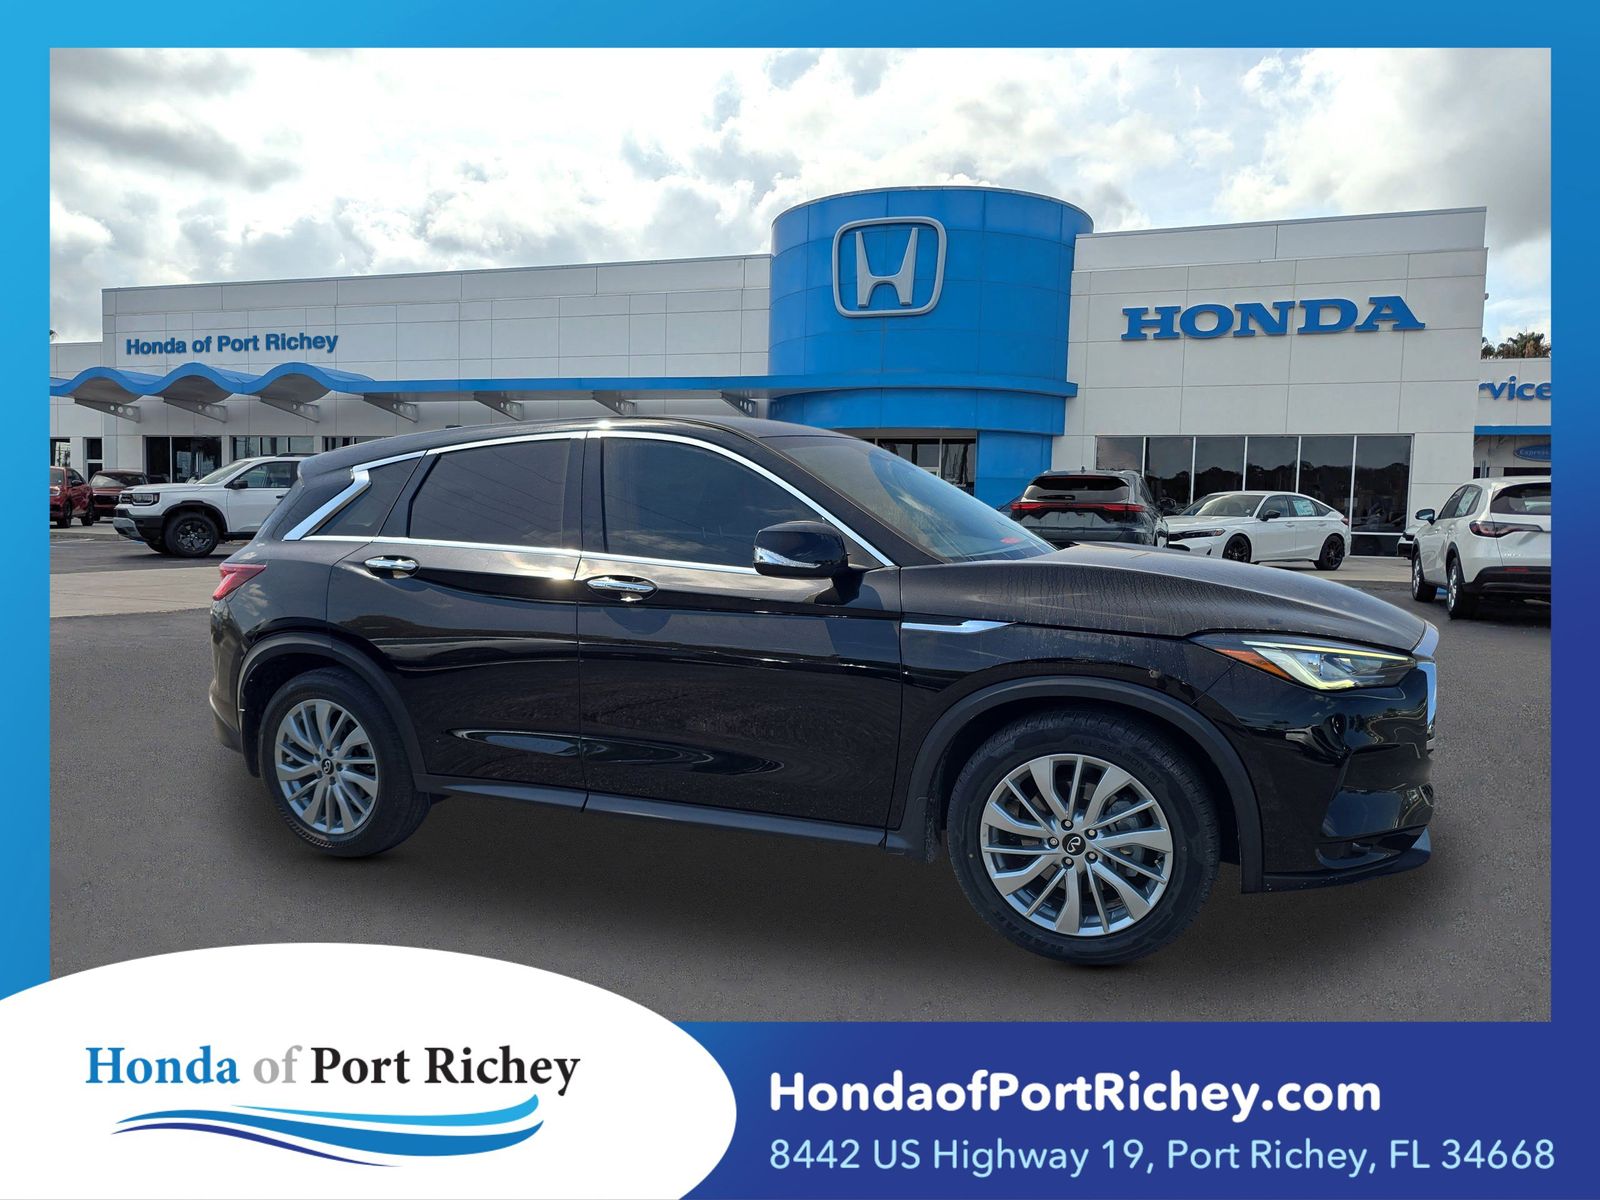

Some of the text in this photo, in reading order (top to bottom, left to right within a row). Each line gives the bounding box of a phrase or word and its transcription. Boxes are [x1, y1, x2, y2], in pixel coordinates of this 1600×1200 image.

[1121, 295, 1425, 340] HONDA
[126, 332, 339, 355] Honda of Port Richey
